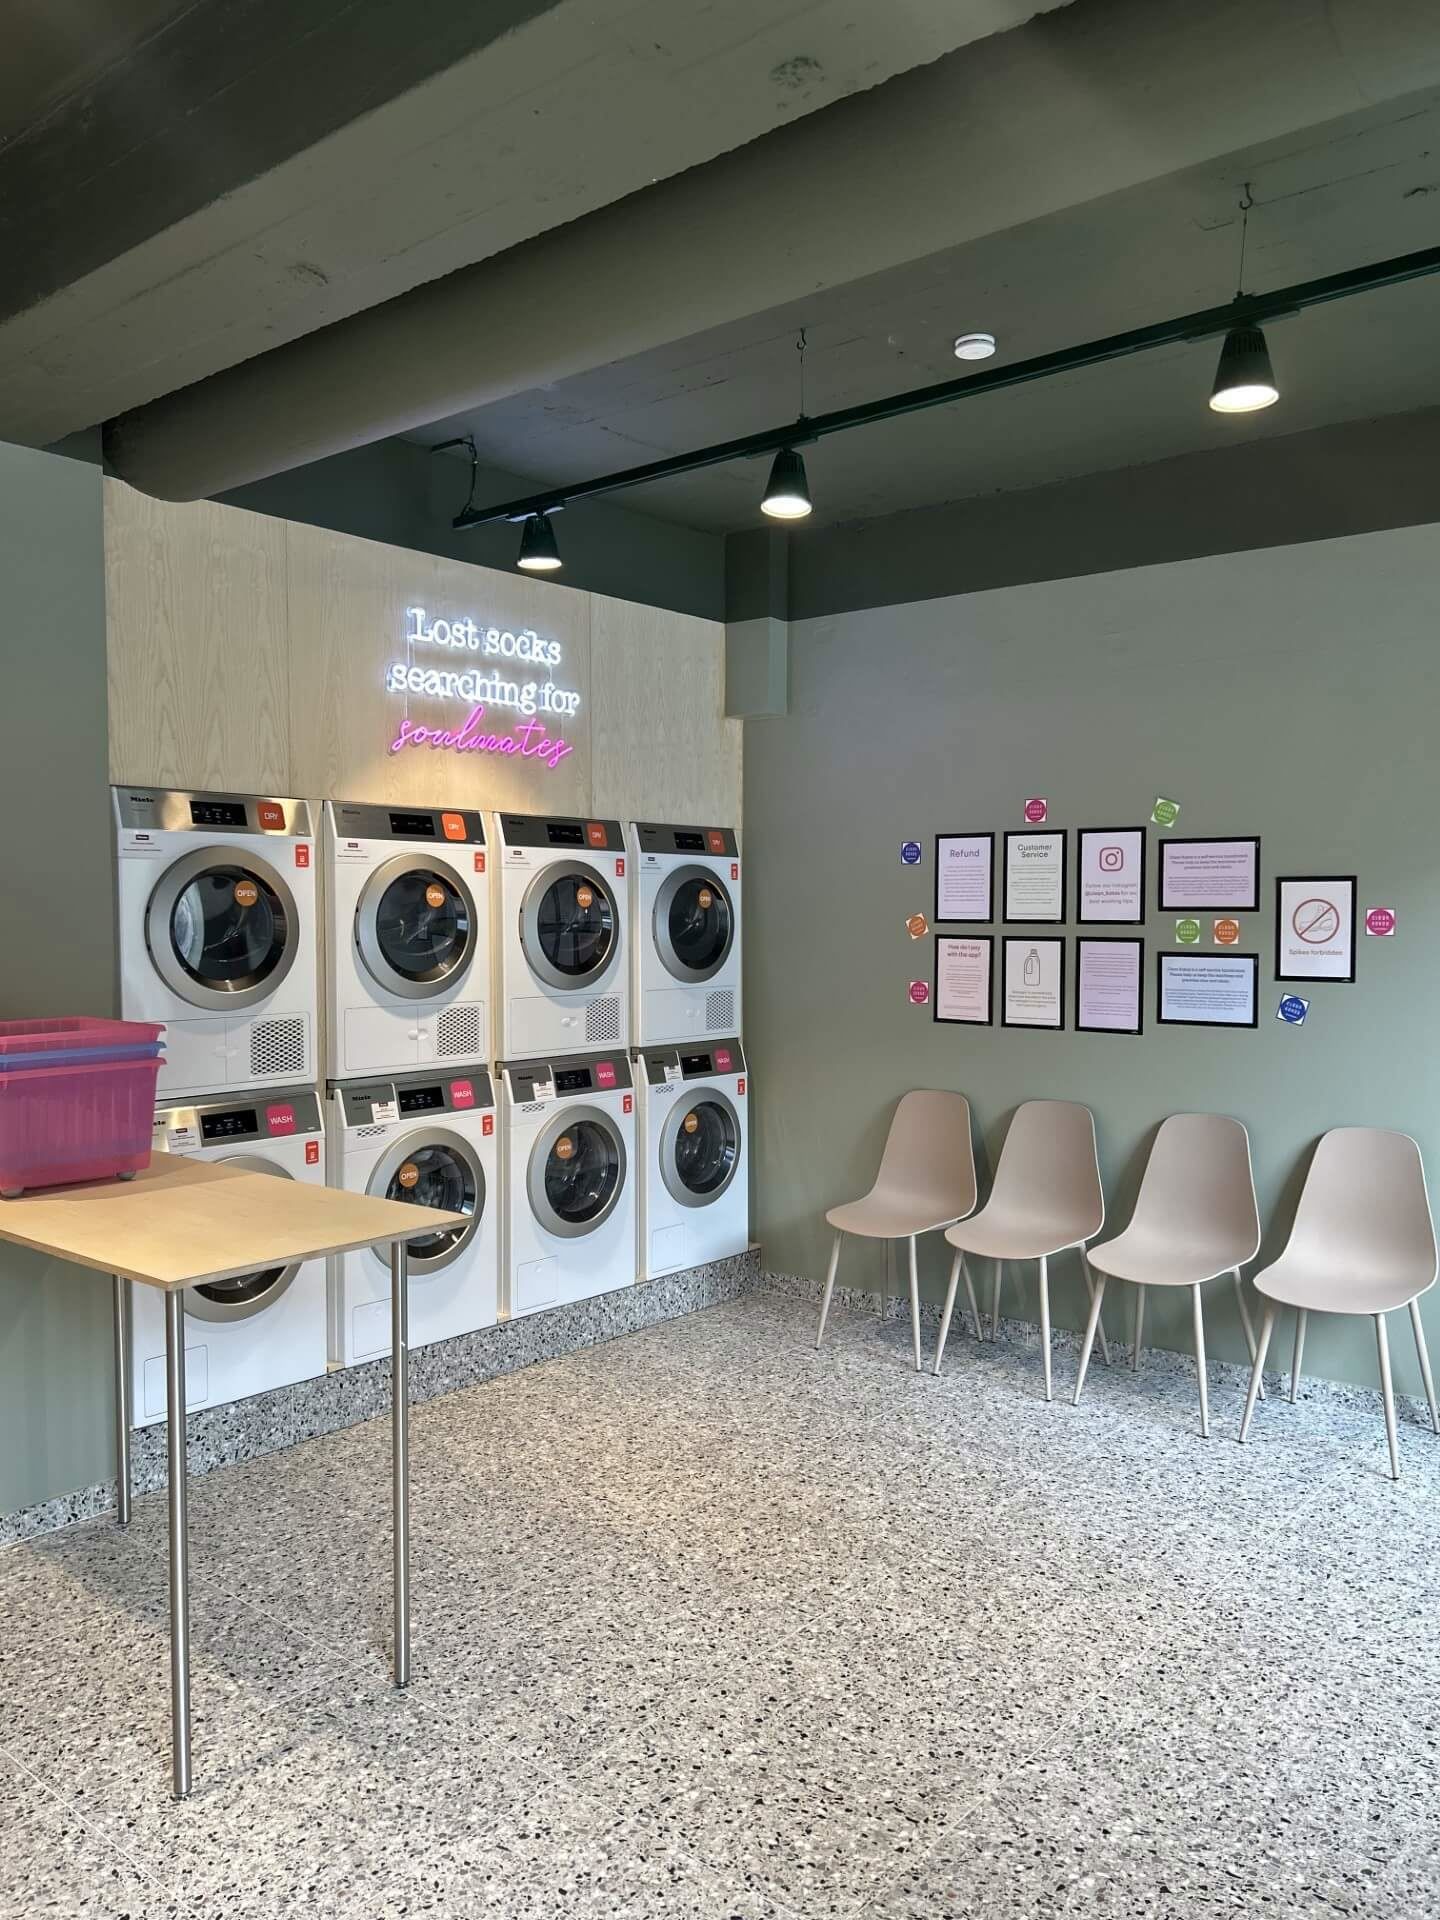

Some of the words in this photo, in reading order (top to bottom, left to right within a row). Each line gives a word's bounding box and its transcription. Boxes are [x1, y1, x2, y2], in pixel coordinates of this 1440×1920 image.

[406, 606, 480, 650] Lost
[483, 627, 562, 666] socks
[387, 662, 537, 716] searching
[538, 683, 581, 718] for
[390, 704, 574, 769] soulmates
[264, 811, 278, 820] DRY
[1017, 843, 1052, 851] Customer
[949, 848, 980, 858] Refund
[237, 889, 257, 897] OPEN
[453, 1089, 472, 1099] WASH
[269, 1115, 293, 1125] WASH
[401, 1171, 417, 1180] OPEN
